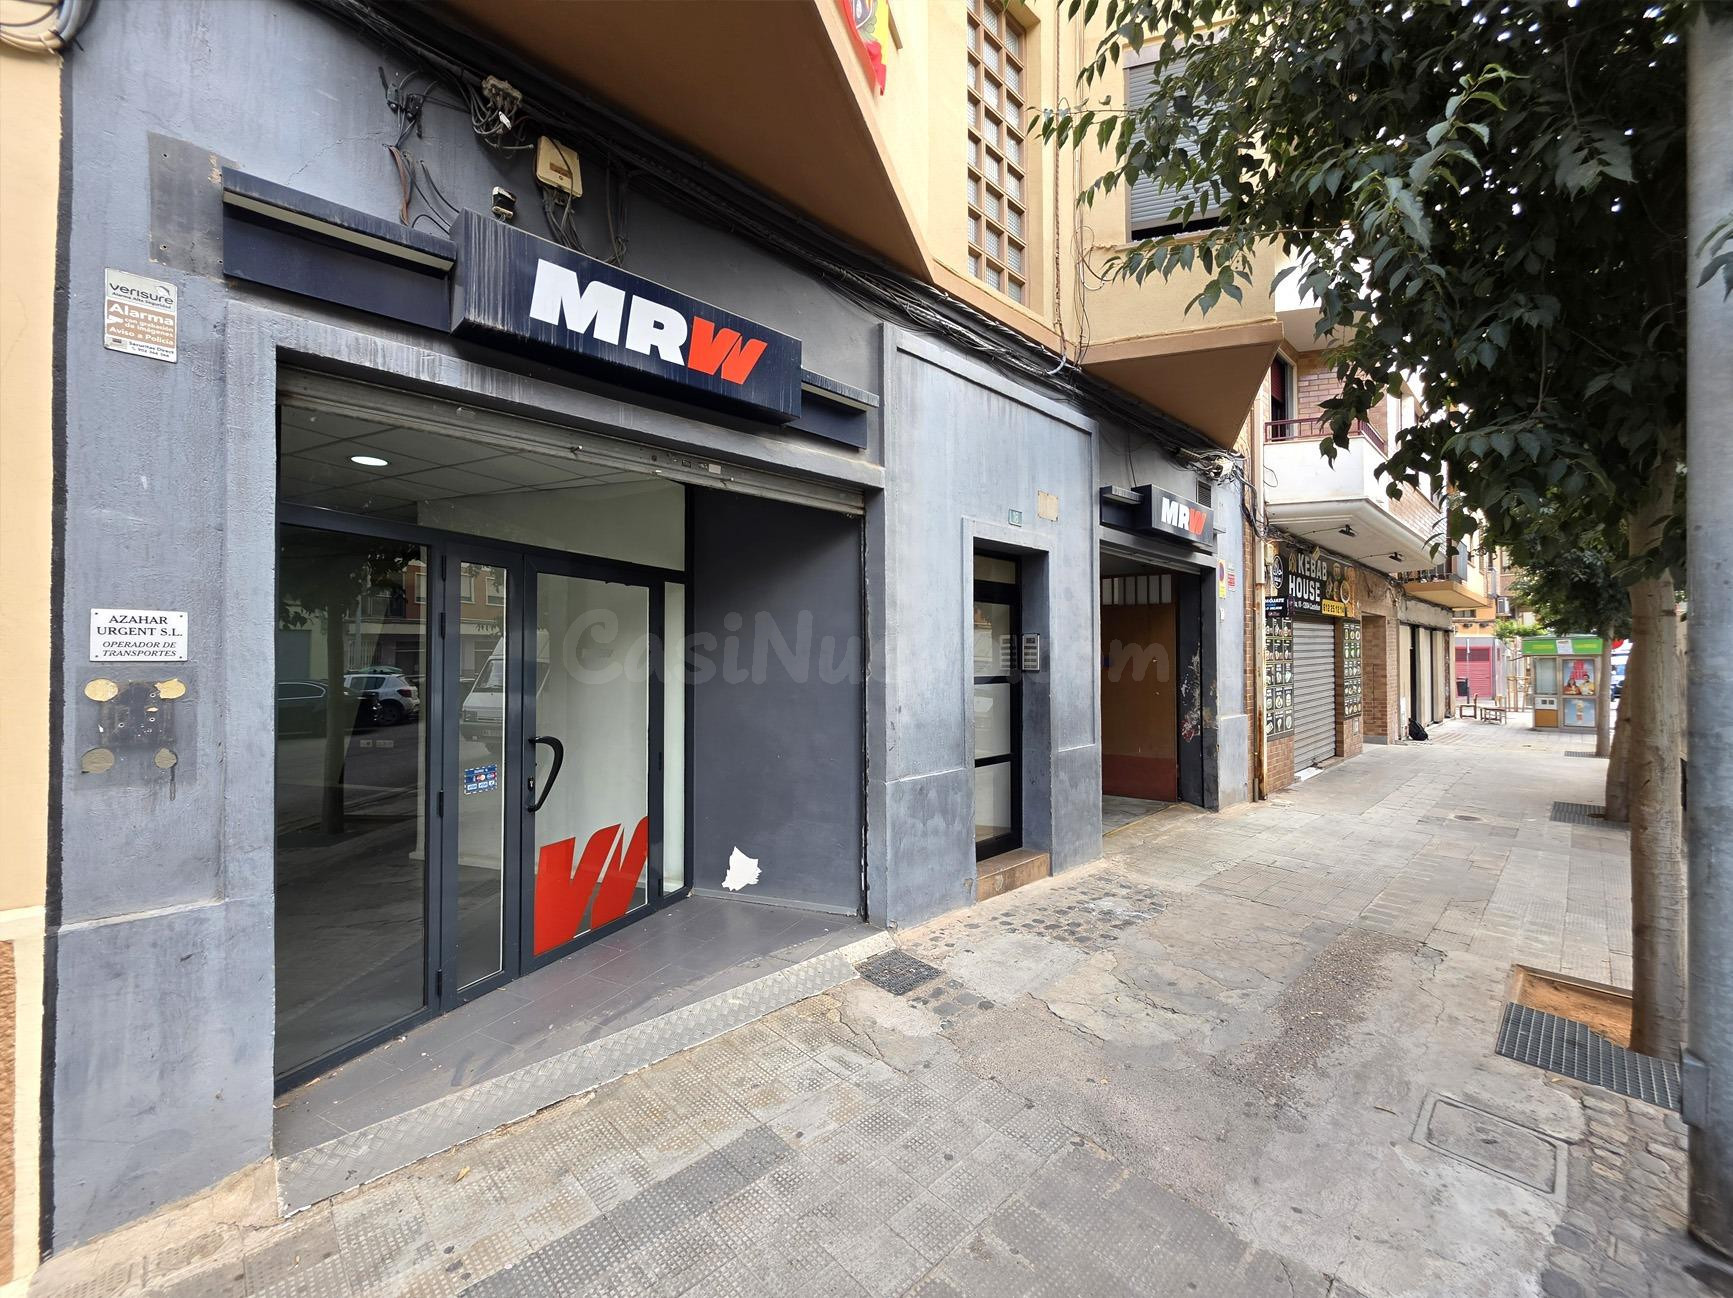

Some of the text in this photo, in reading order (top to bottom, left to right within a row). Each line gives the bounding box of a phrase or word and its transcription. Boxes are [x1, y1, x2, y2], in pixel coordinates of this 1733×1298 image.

[109, 282, 174, 305] verisure
[108, 303, 174, 326] Alarma
[529, 258, 768, 386] MRW
[109, 326, 135, 337] Aviso
[145, 333, 174, 346] Policía
[1160, 496, 1207, 536] MRW
[1298, 554, 1327, 581] KEBAB
[1288, 574, 1321, 602] HOUSE
[109, 615, 168, 625] AZAHAR
[96, 626, 183, 638] URGENT S.L.
[102, 640, 177, 649] OPERADOR DE
[102, 649, 177, 658] TRANSPORTES
